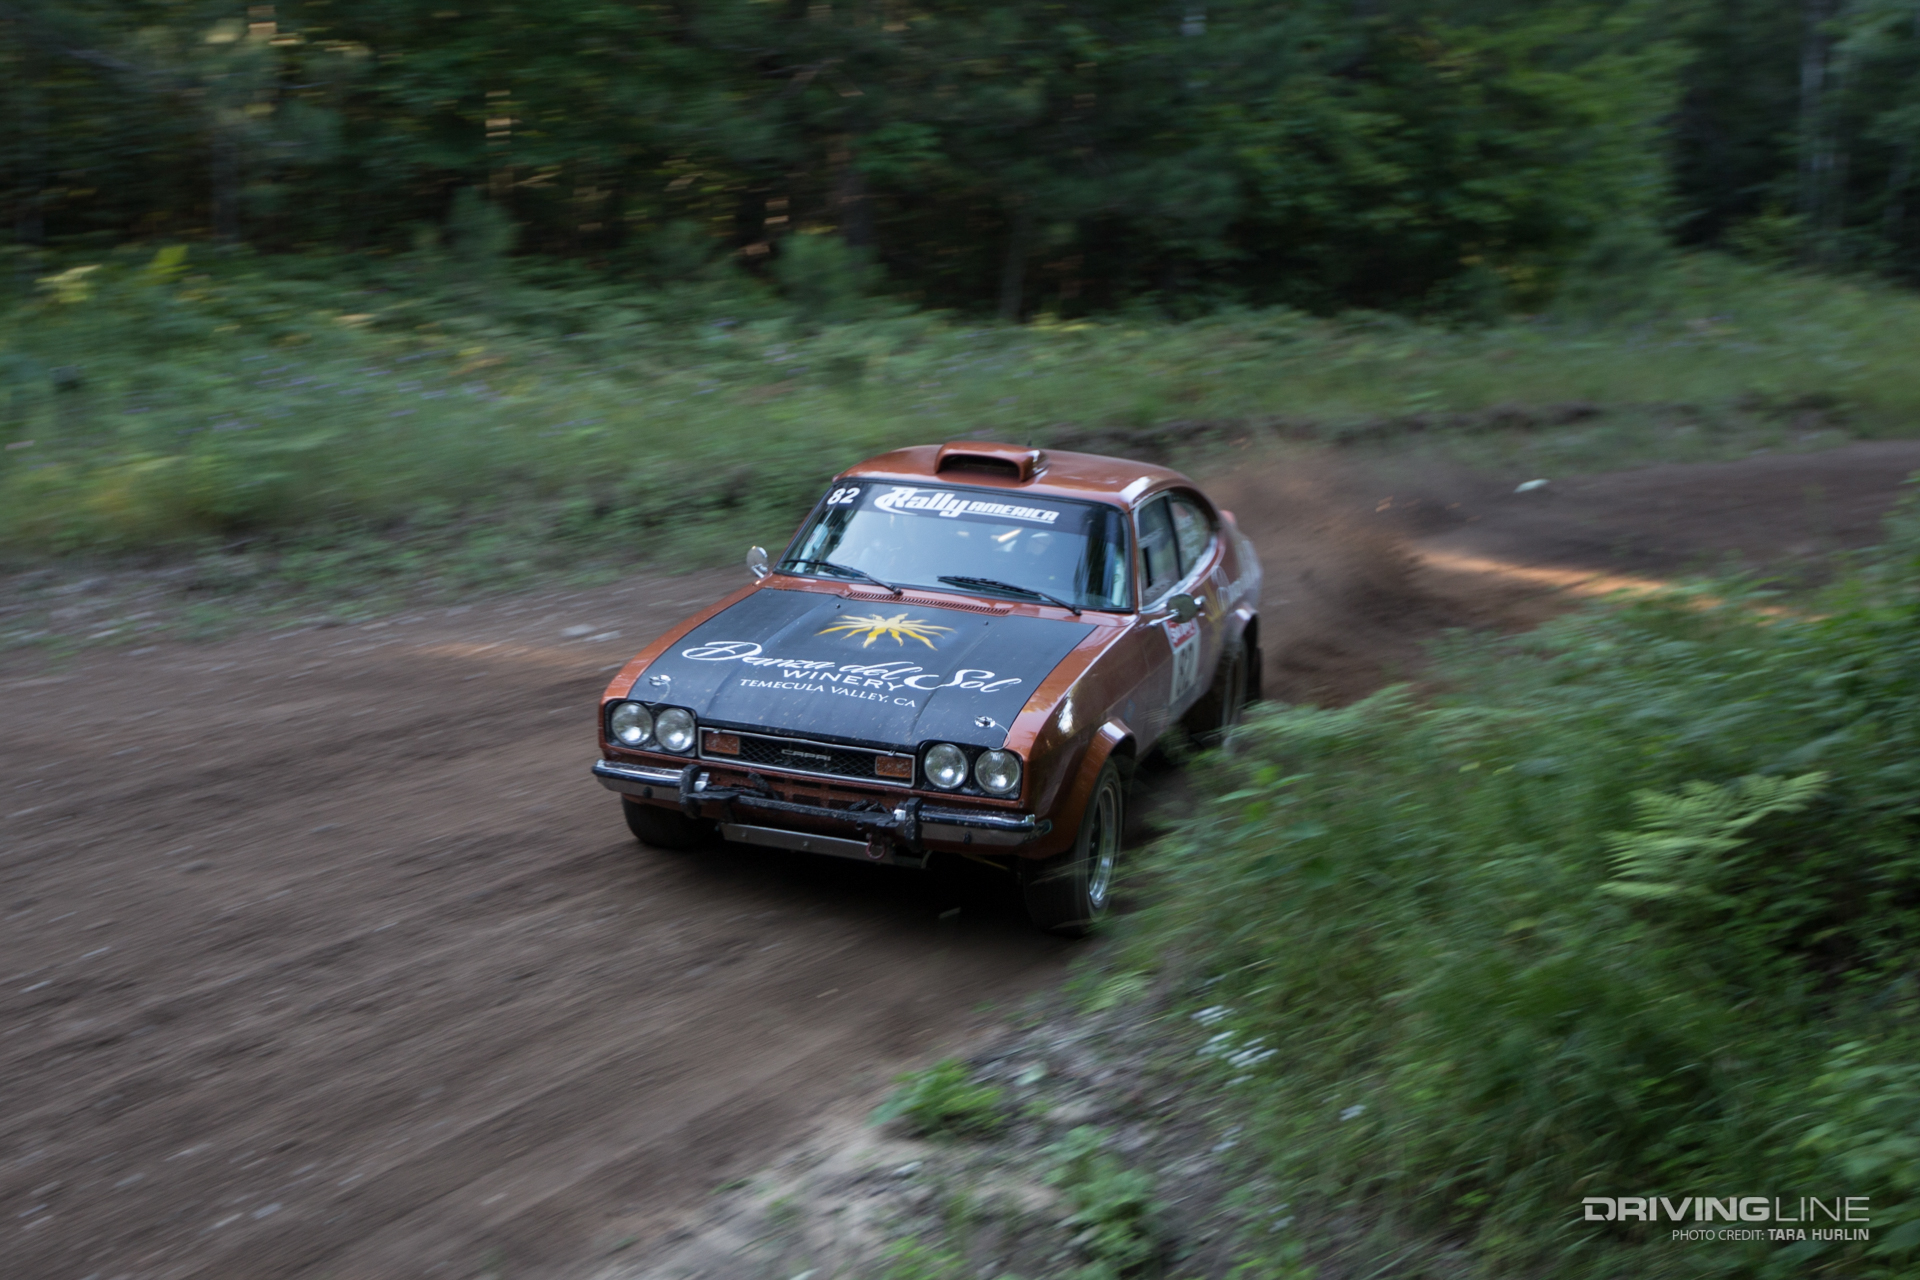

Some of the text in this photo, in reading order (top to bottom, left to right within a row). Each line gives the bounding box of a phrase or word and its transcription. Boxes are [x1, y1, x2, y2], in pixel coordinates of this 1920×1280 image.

[827, 487, 860, 505] 82
[873, 486, 1060, 523] Rally AMERICA
[681, 640, 1023, 693] Danza del Sol
[739, 678, 917, 708] TEMECULA VALLEY, CA
[783, 669, 904, 692] WINERY
[781, 749, 831, 761] CAPRI
